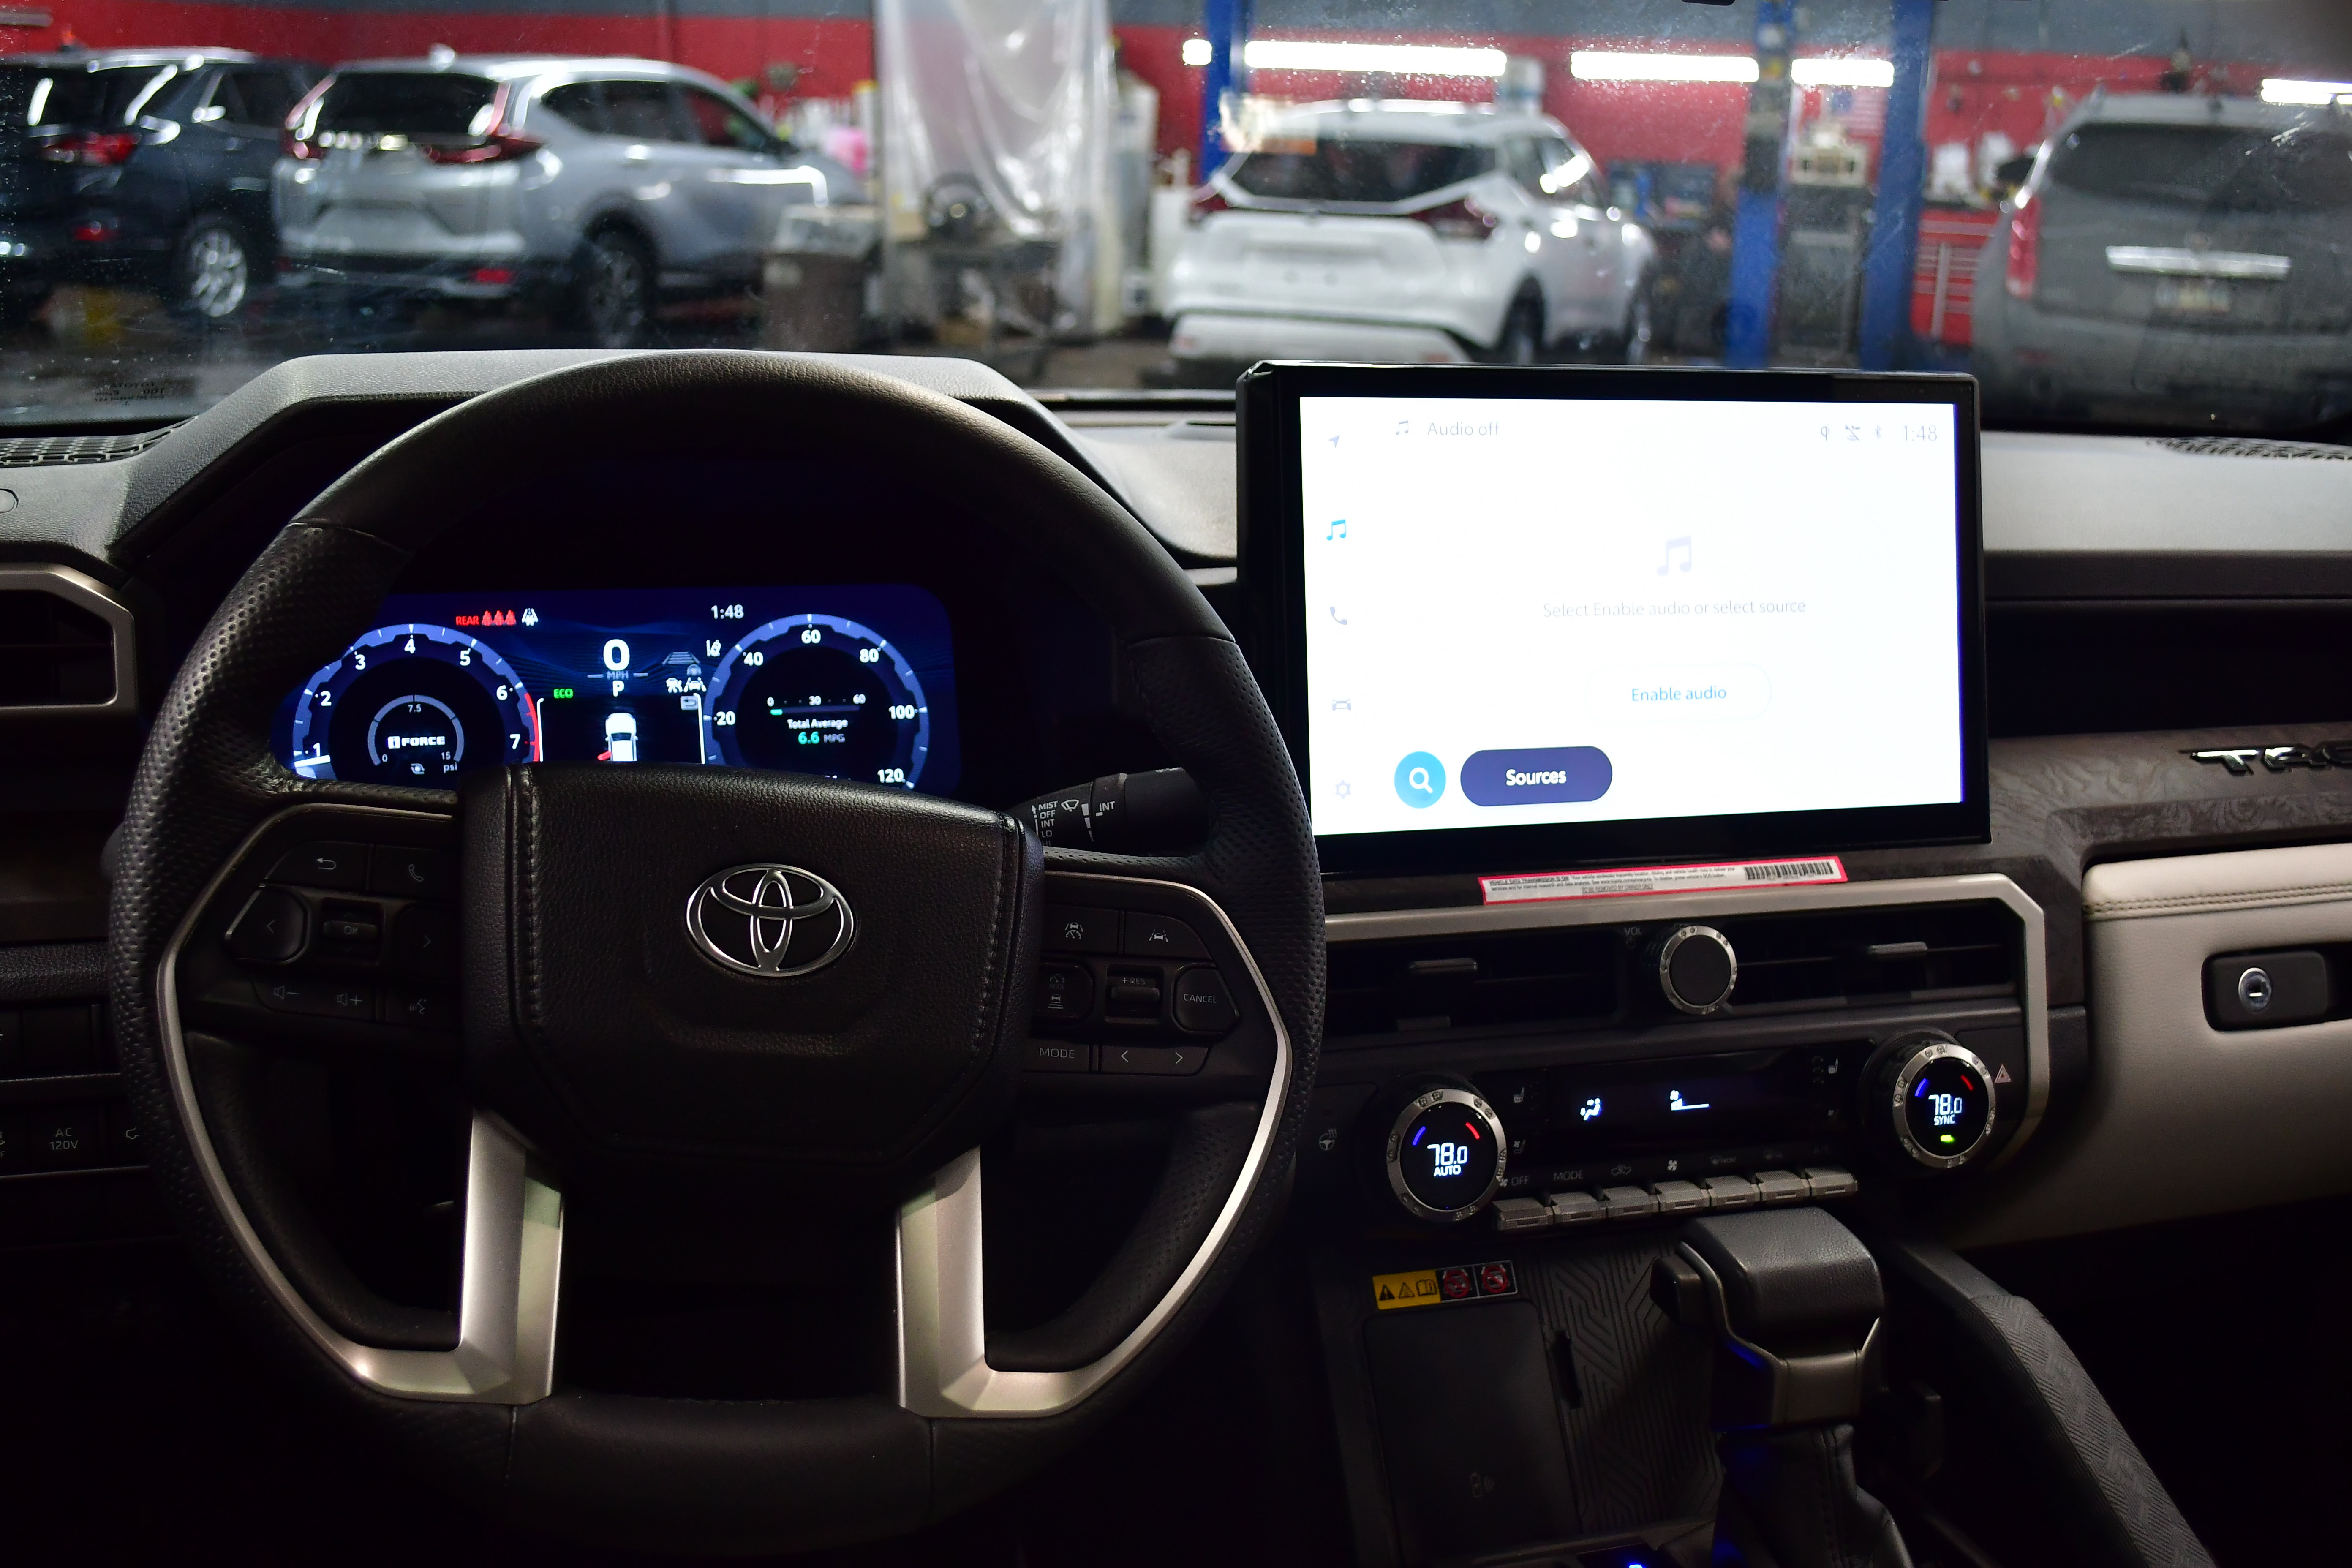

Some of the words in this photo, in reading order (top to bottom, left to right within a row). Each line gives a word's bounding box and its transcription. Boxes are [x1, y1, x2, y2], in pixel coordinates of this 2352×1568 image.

[1428, 422, 1473, 436] Audio
[1478, 422, 1499, 436] off
[1903, 425, 1937, 442] 1:48
[711, 604, 744, 619] 1:48
[1544, 603, 1588, 617] Select
[1594, 602, 1644, 615] Enable
[1649, 601, 1690, 615] audio
[1694, 604, 1708, 614] or
[1713, 600, 1754, 613] select
[1759, 602, 1805, 612] source
[456, 615, 479, 626] REAR
[801, 629, 821, 644] 60
[404, 639, 416, 654] 4
[460, 652, 470, 666] 5
[603, 639, 630, 671] 0
[744, 653, 764, 666] 40
[859, 648, 879, 663] 80
[355, 654, 367, 670] 3
[607, 671, 629, 680] MPH
[496, 685, 508, 701] 6
[553, 688, 573, 699] ECO
[612, 681, 625, 697] P
[1632, 687, 1681, 701] Enable
[1686, 686, 1726, 700] audio
[320, 691, 332, 706] 2
[767, 697, 774, 707] 0
[809, 695, 822, 706] 30
[853, 694, 866, 704] 60
[408, 704, 422, 713] 7.5
[888, 705, 914, 720] 100
[717, 711, 736, 726] 20
[787, 718, 811, 729] Total
[811, 718, 848, 730] Average
[509, 733, 521, 750] 7
[798, 731, 820, 745] 6.6
[823, 733, 845, 743] MPG
[313, 743, 321, 756] 1
[441, 751, 451, 760] 15
[382, 754, 388, 762] 0
[443, 762, 457, 773] psi
[877, 769, 903, 784] 120
[1506, 769, 1567, 786] Sources
[1038, 801, 1058, 811] MIST
[1099, 801, 1115, 811] INT
[1040, 811, 1056, 819] OFF
[1041, 819, 1055, 828] INT
[1041, 830, 1052, 838] LO
[345, 926, 358, 934] OK
[1624, 926, 1641, 936] VOL
[1183, 994, 1217, 1003] CANCEL
[1040, 1048, 1075, 1059] MODE
[1928, 1094, 1963, 1116] 78.0
[1934, 1115, 1956, 1126] SYNC
[55, 1127, 72, 1137] AC
[49, 1140, 79, 1150] 120V
[1427, 1142, 1468, 1166] 78.0
[1434, 1165, 1462, 1177] AUTO
[1553, 1170, 1583, 1181] MODE
[1511, 1175, 1529, 1186] OFF
